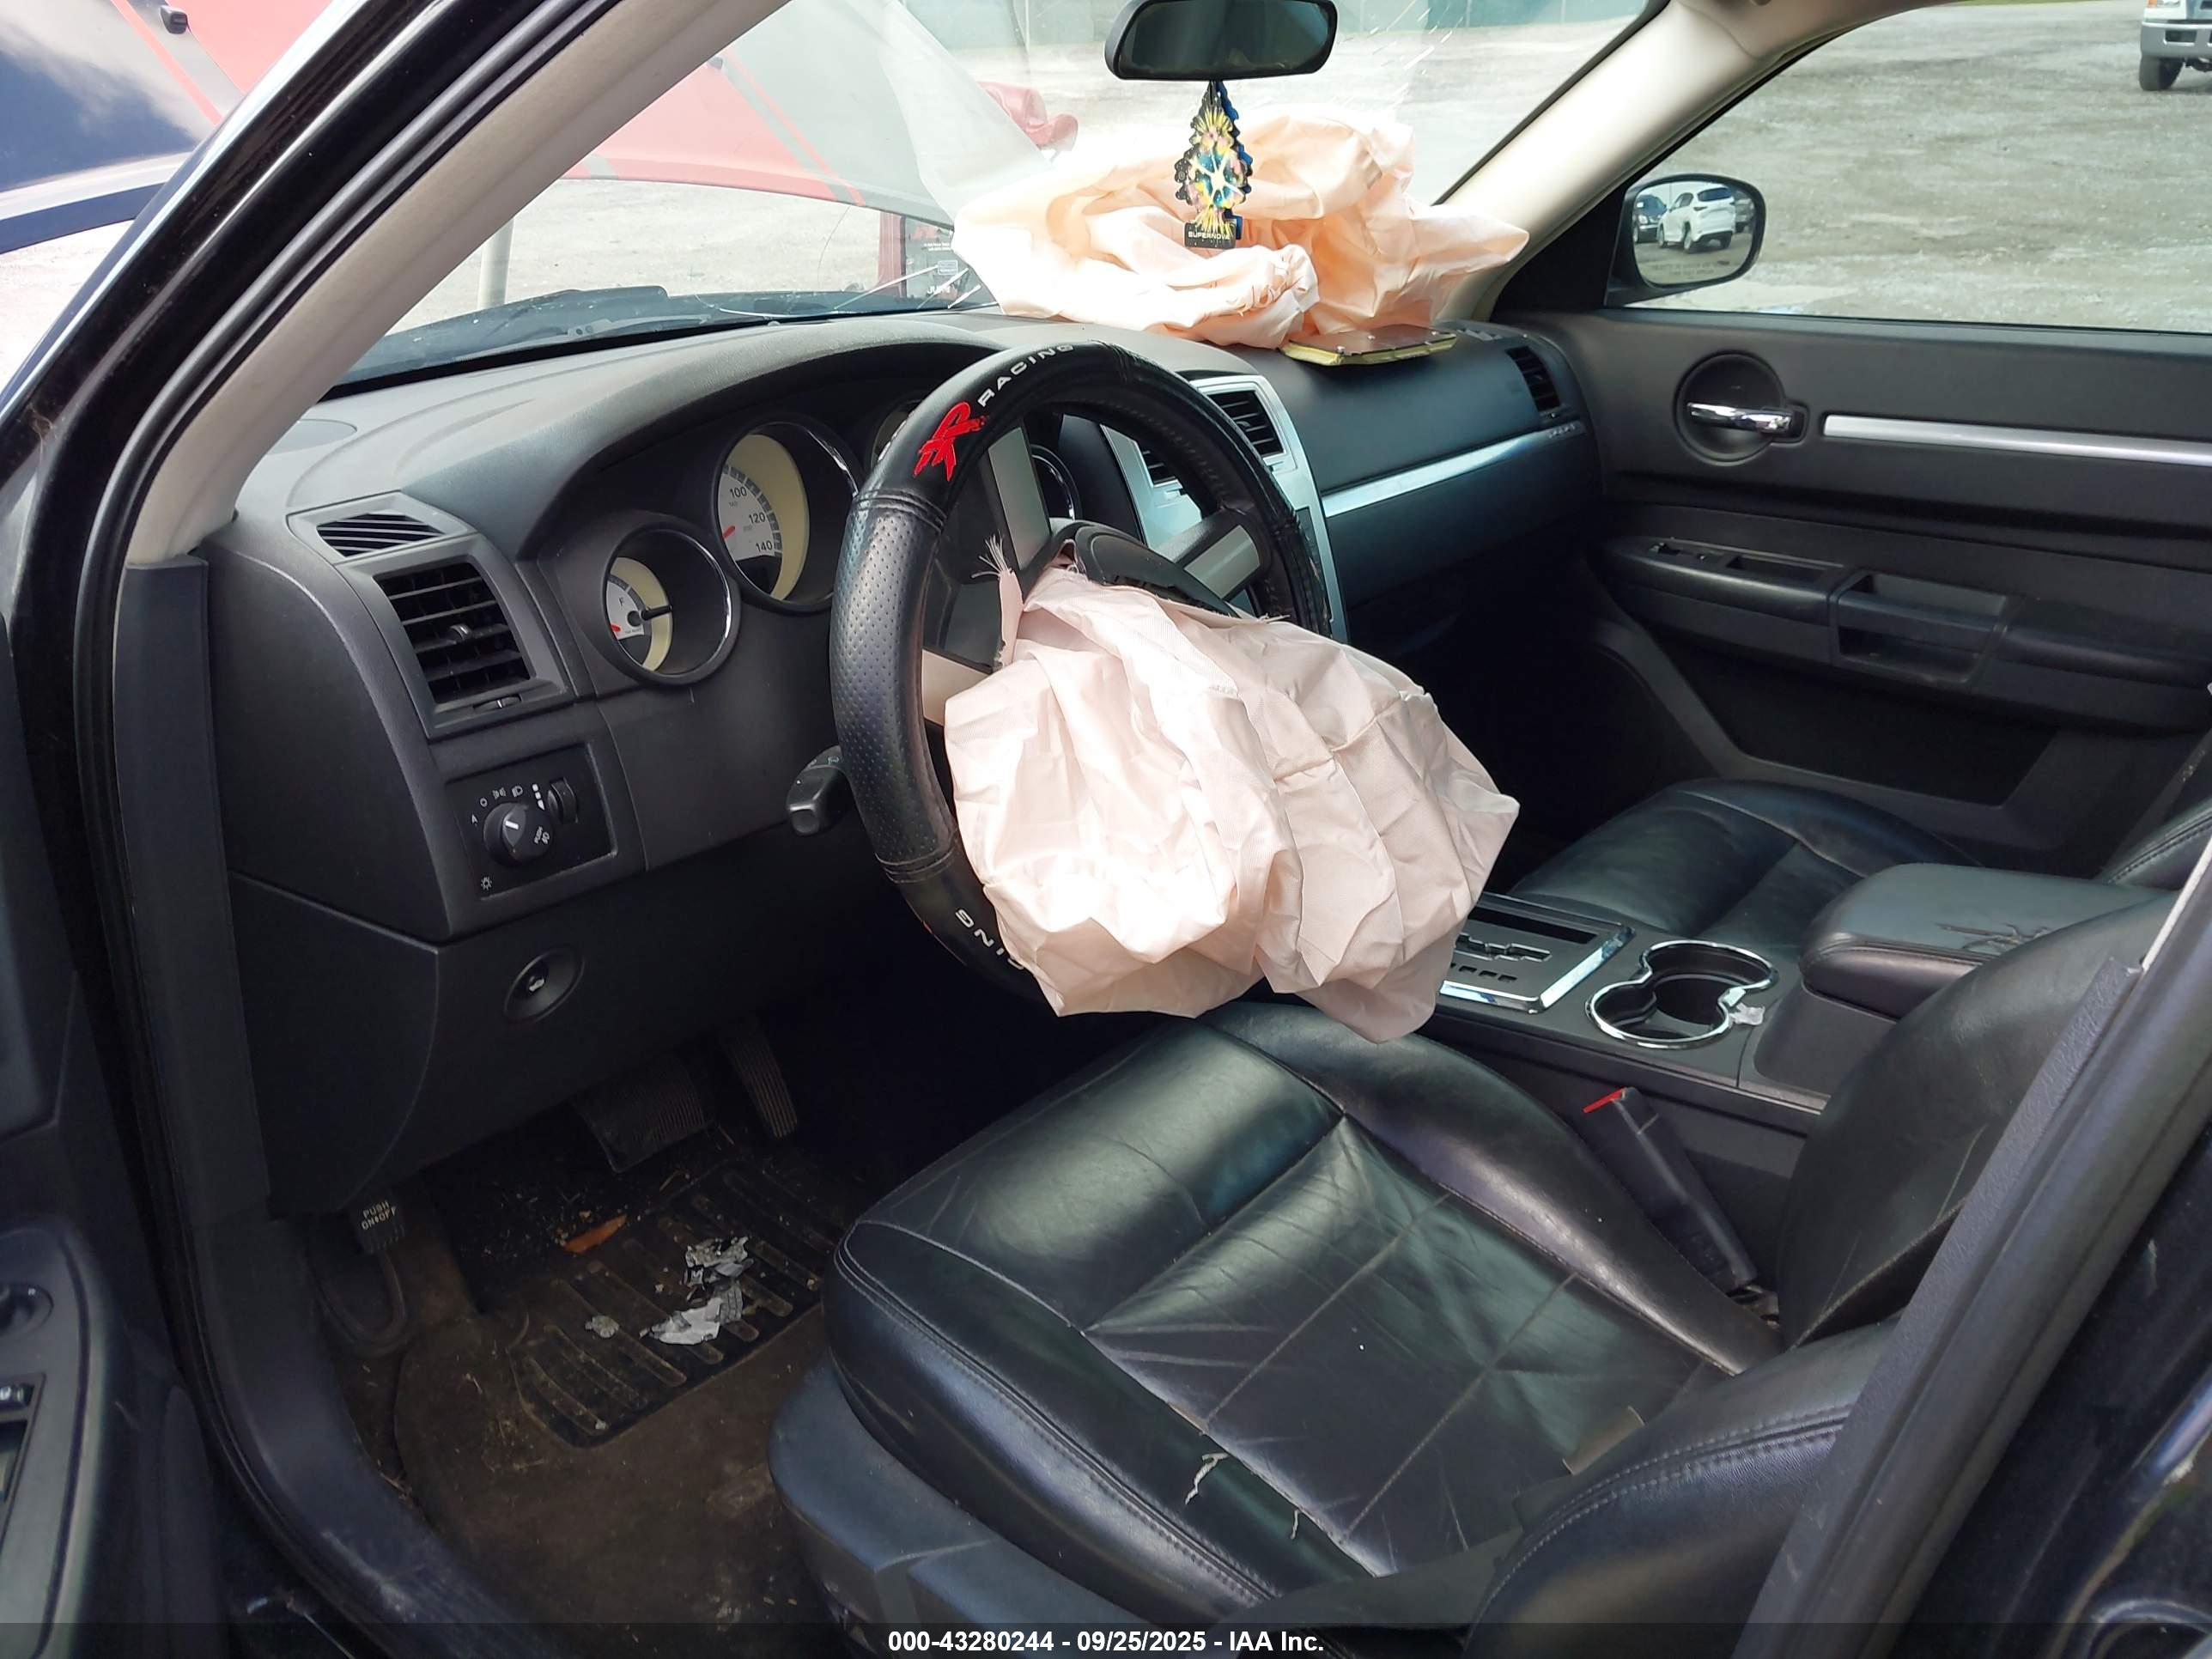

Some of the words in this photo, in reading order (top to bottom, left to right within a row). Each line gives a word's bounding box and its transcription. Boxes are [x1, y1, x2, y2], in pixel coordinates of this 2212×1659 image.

[1188, 231, 1231, 240] SUPERNOVA
[977, 343, 1075, 407] RACING
[729, 486, 748, 499] 100
[749, 512, 767, 525] 120
[756, 540, 773, 553] 140
[362, 1200, 390, 1218] PUSH
